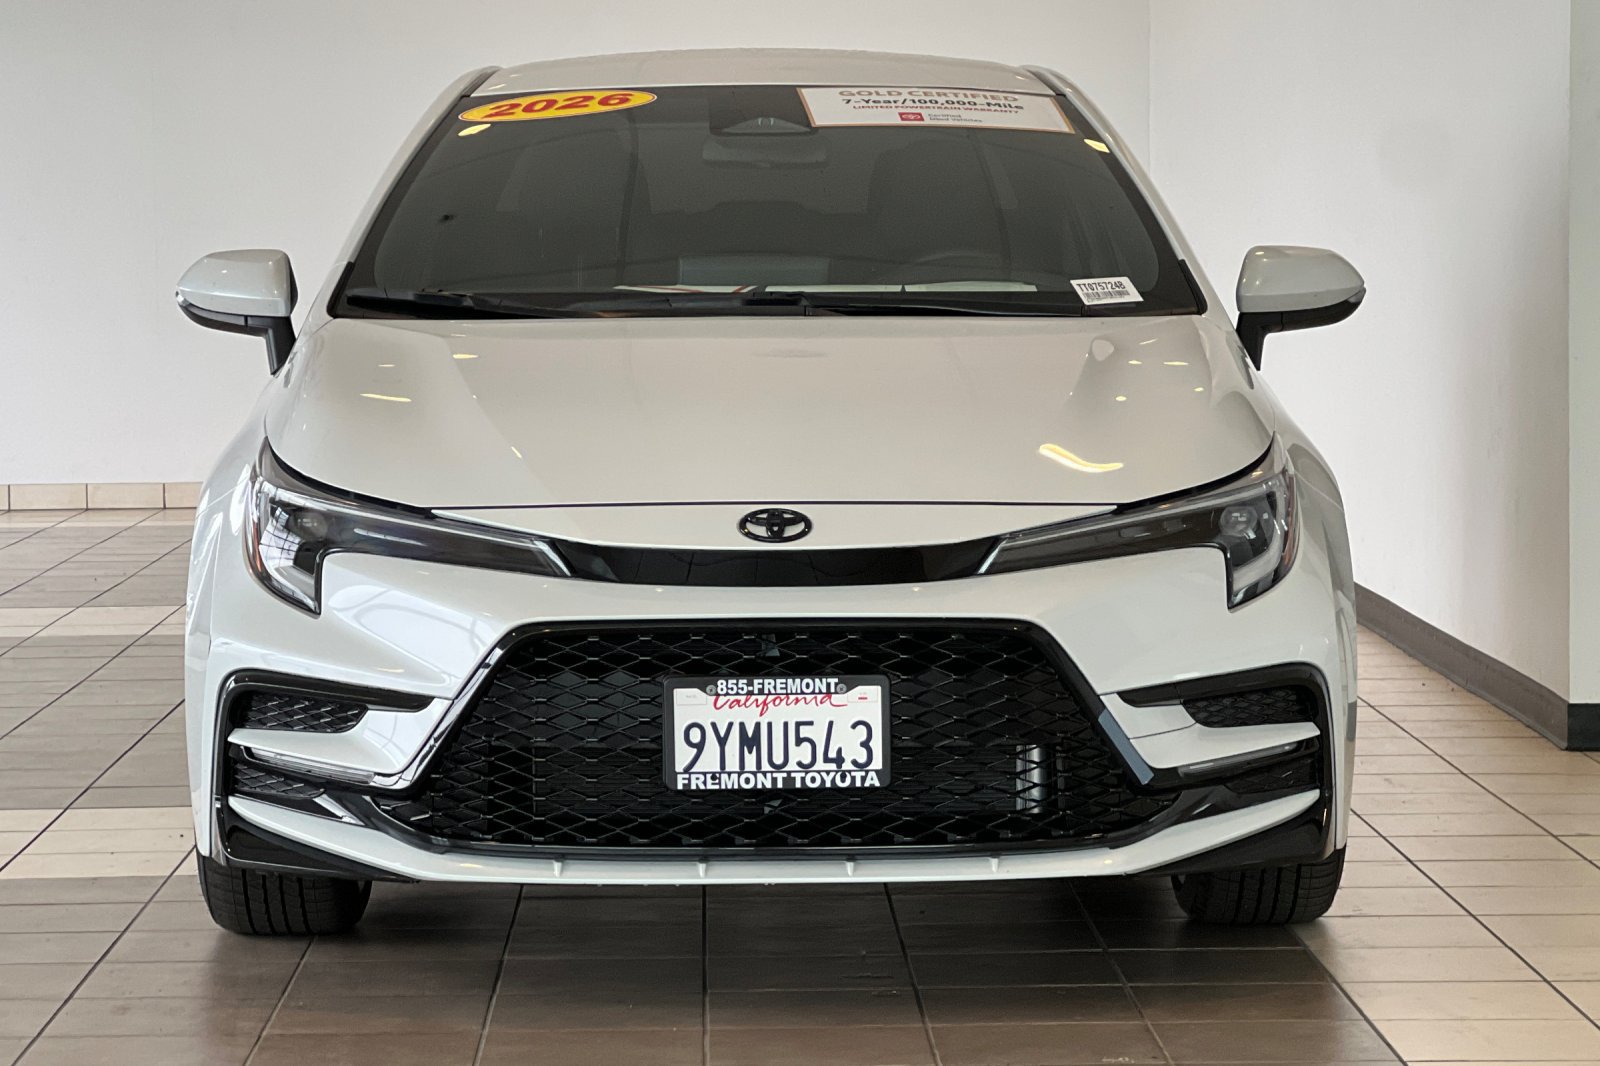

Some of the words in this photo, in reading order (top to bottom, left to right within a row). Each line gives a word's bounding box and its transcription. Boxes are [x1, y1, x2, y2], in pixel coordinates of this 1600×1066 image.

[842, 98, 1024, 110] 7-Year/100,000-Mile
[907, 90, 1019, 102] CERTIFIED
[480, 93, 635, 119] 2026
[962, 106, 1019, 114] WARRANTY
[716, 678, 839, 695] 855-FREMONT
[712, 694, 848, 717] California
[683, 720, 873, 773] 9YMU543
[676, 773, 787, 790] FREMONT
[790, 771, 880, 788] TOYOTA
